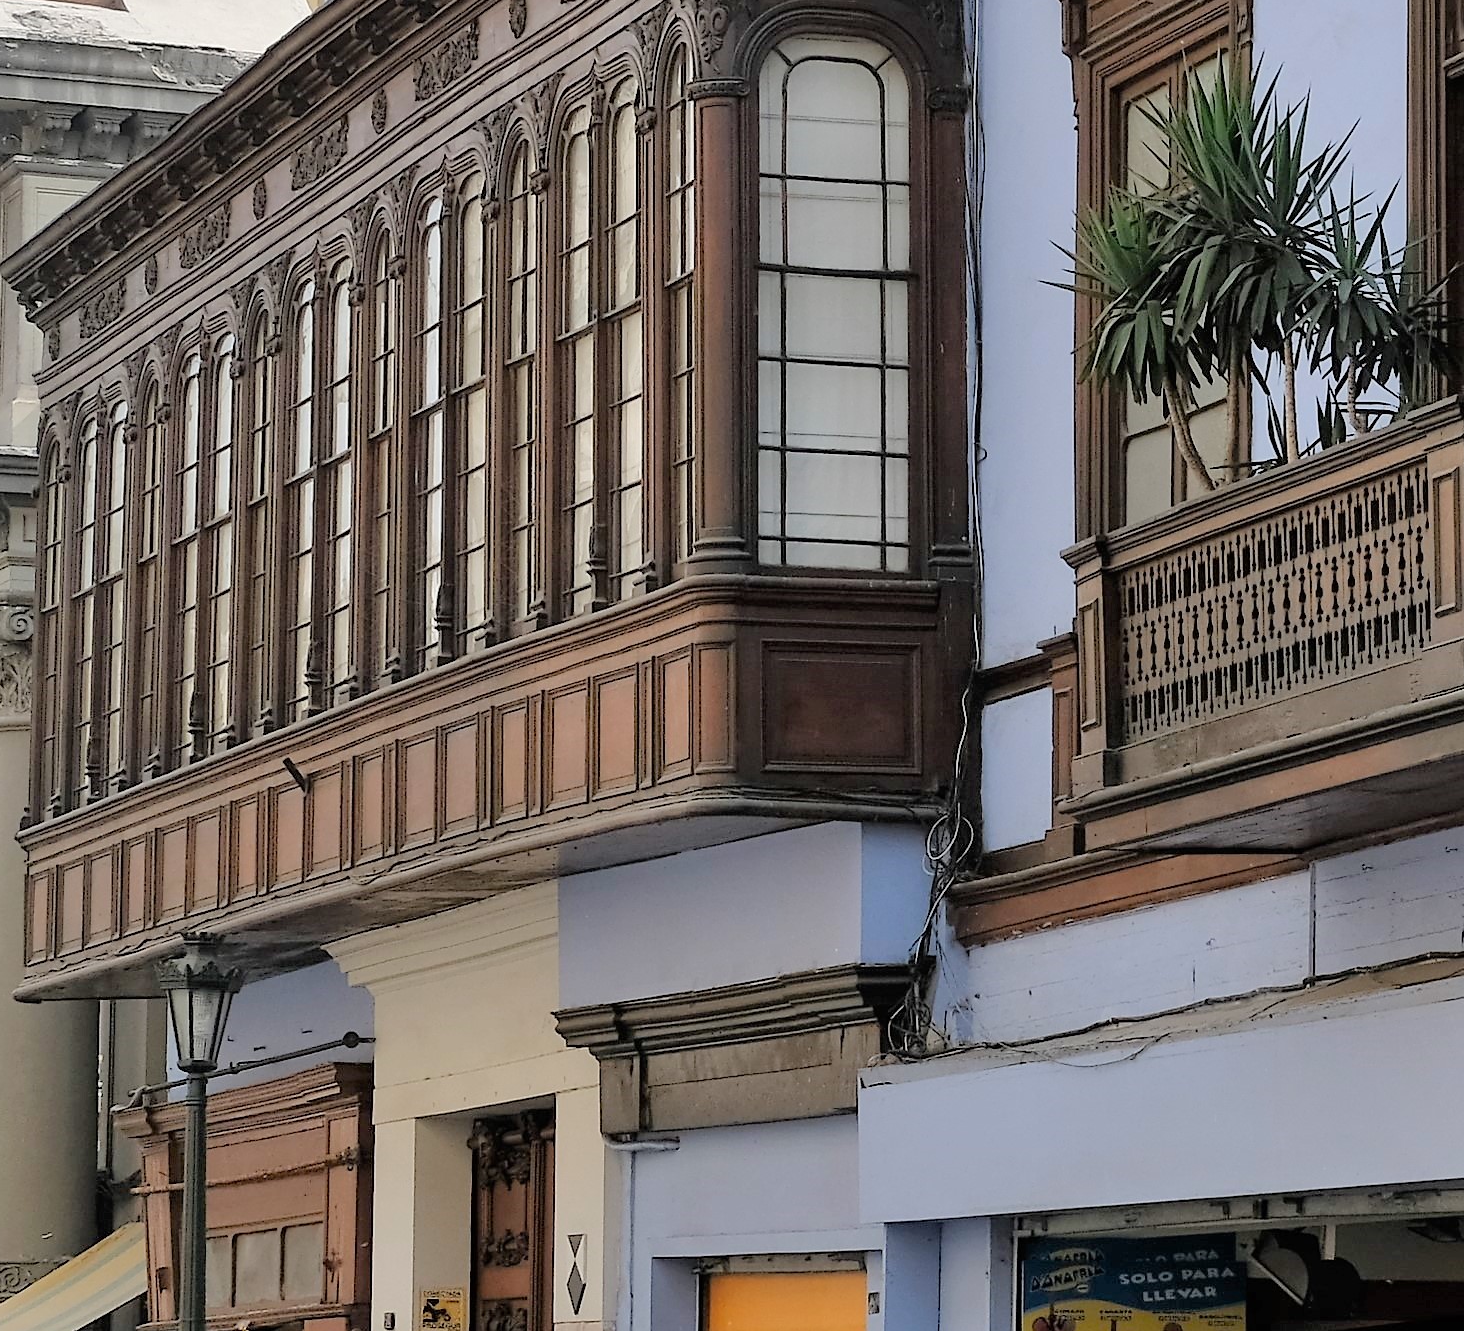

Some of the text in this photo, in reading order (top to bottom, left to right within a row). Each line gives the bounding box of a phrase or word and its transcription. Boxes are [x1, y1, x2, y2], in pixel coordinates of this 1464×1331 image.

[1118, 1266, 1236, 1285] SOLO PARA
[1142, 1285, 1217, 1303] LLEVAR
